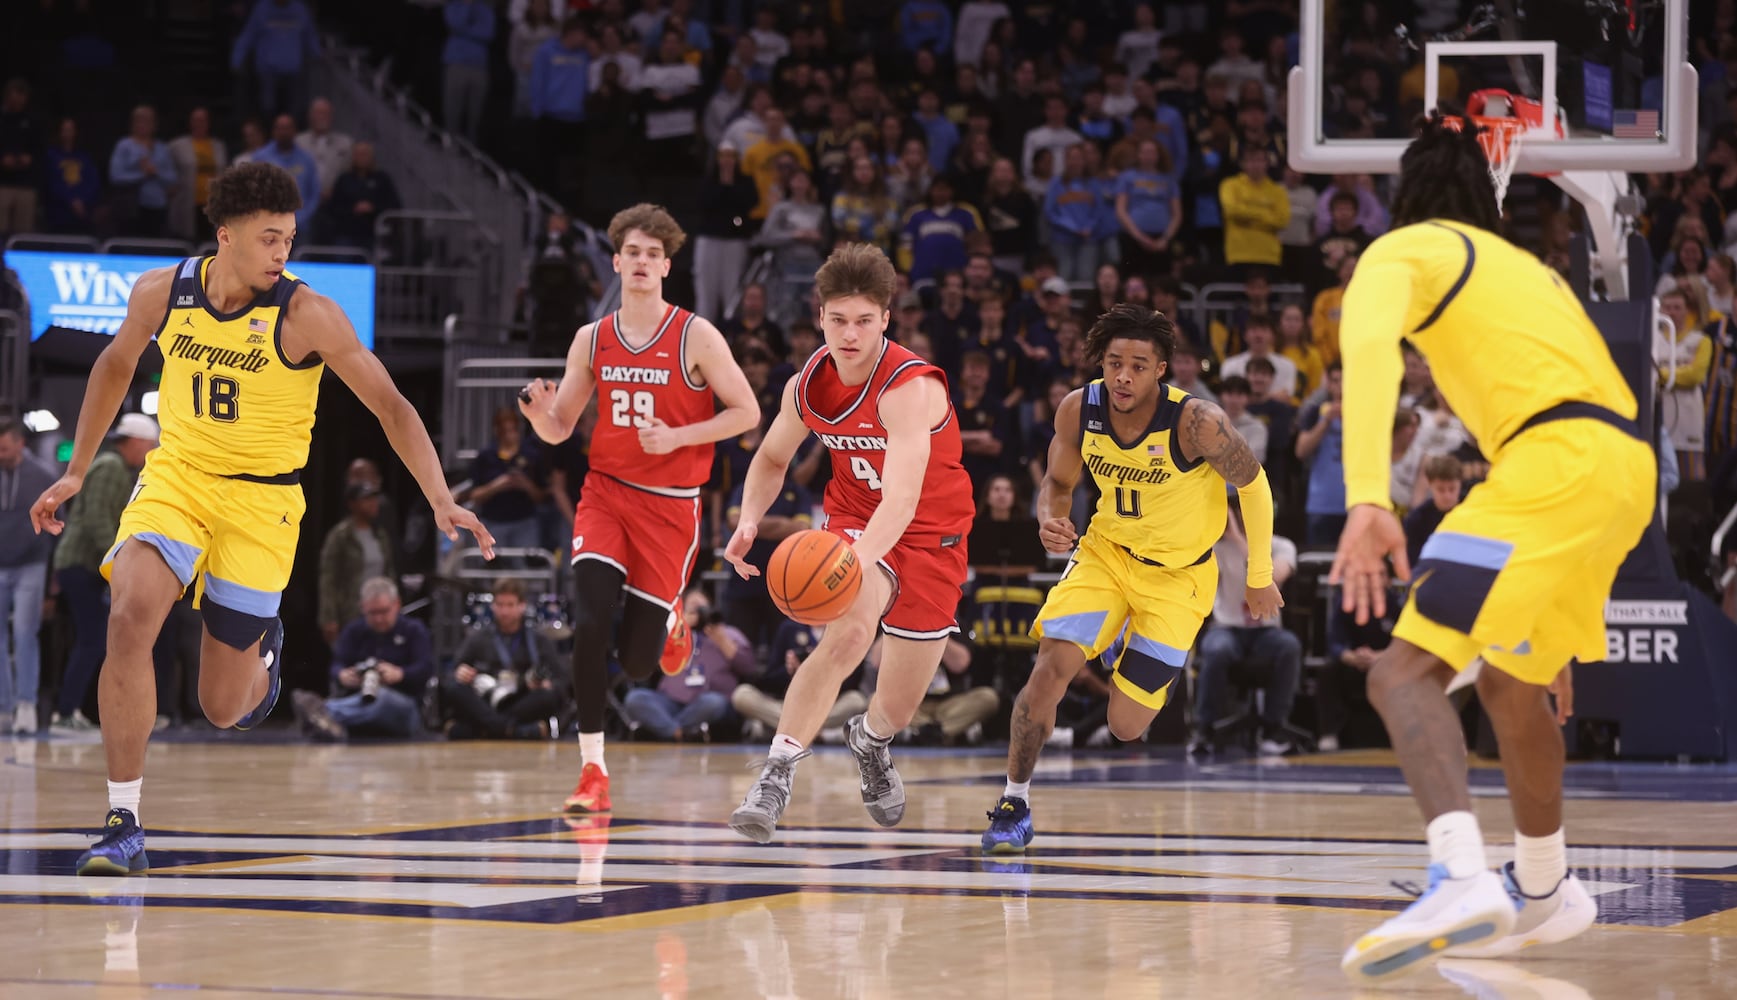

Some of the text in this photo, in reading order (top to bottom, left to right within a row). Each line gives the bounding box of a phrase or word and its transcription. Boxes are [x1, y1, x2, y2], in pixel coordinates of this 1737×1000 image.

[168, 333, 270, 373] Marquette
[601, 365, 671, 385] DAYTON
[191, 371, 240, 423] 18
[610, 389, 655, 429] 29
[821, 433, 888, 451] AYTON
[850, 456, 882, 491] 4
[1086, 453, 1172, 485] Marquette
[823, 551, 856, 591] ELITE
[1613, 607, 1679, 618] THAT'S ALL
